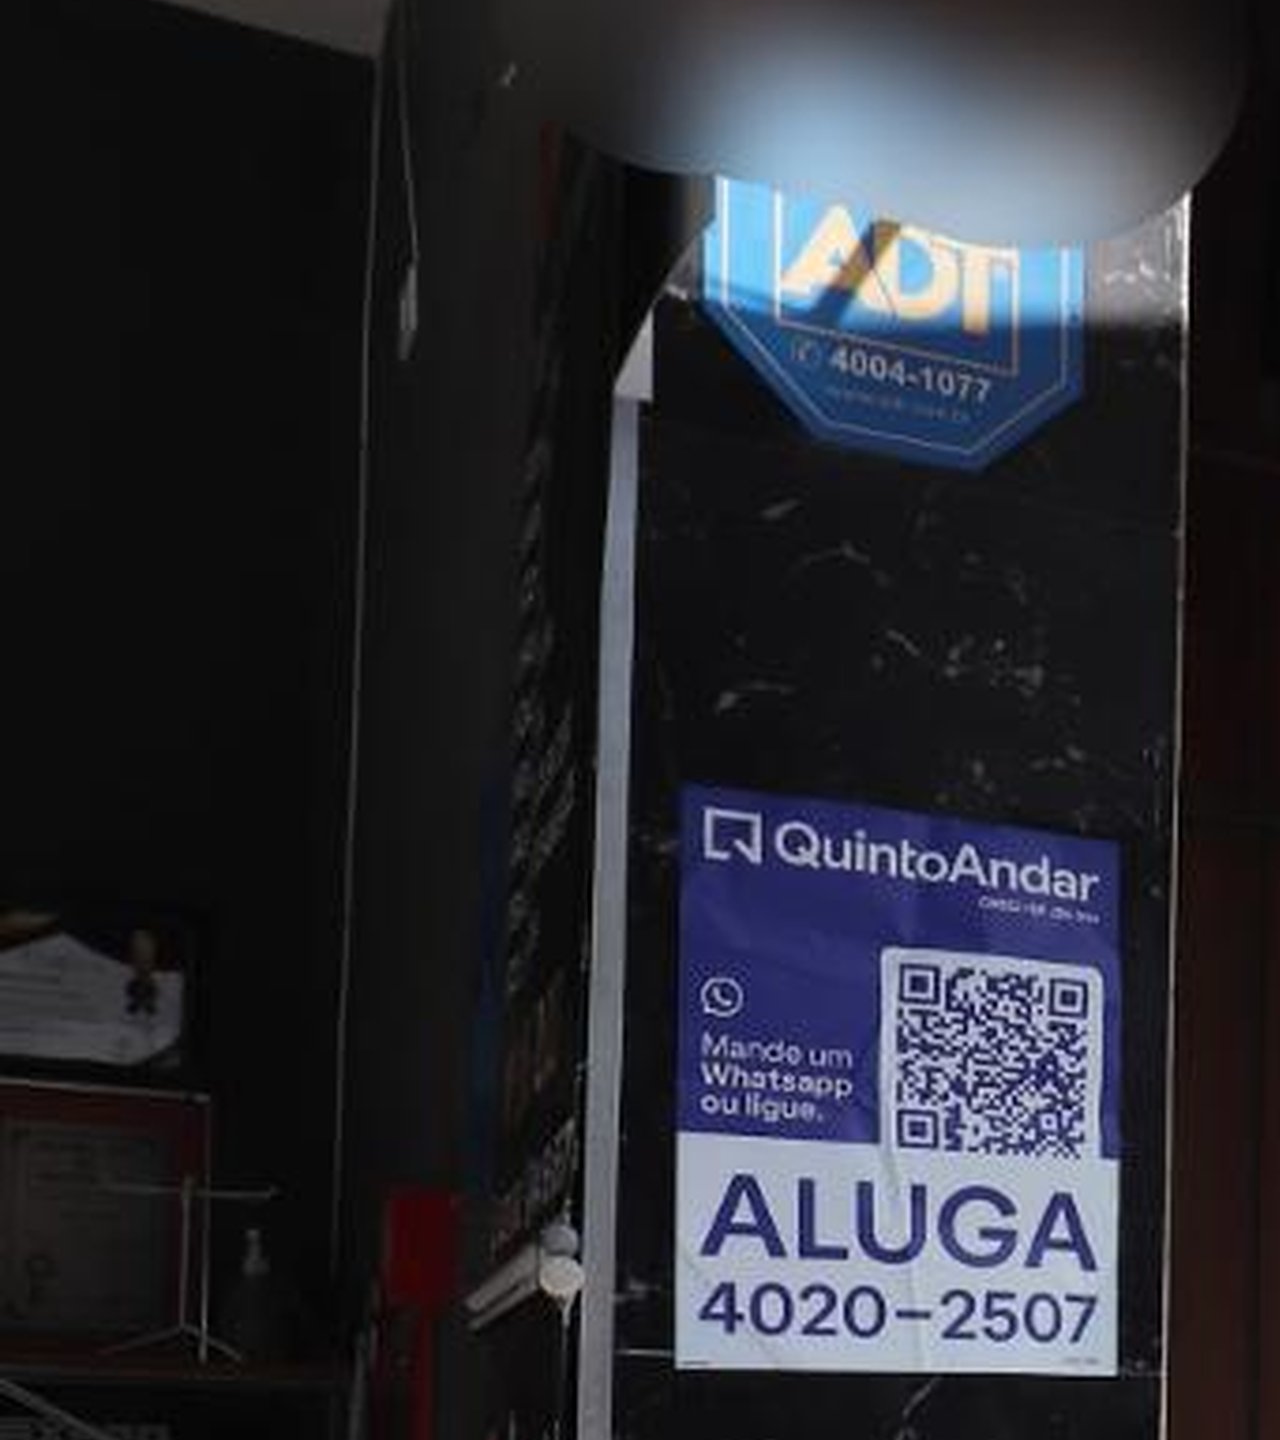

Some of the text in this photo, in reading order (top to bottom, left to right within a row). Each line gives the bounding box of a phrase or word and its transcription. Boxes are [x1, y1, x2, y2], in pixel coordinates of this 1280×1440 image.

[781, 203, 1006, 339] ADT
[832, 346, 991, 404] 4004-1077
[774, 819, 1100, 902] QuintoAndar
[702, 1031, 853, 1069] Mande um
[701, 1061, 852, 1101] Whatsapp
[701, 1092, 823, 1122] ou ligue.
[700, 1173, 1098, 1272] ALUGA
[699, 1281, 1099, 1344] 4020-2507
